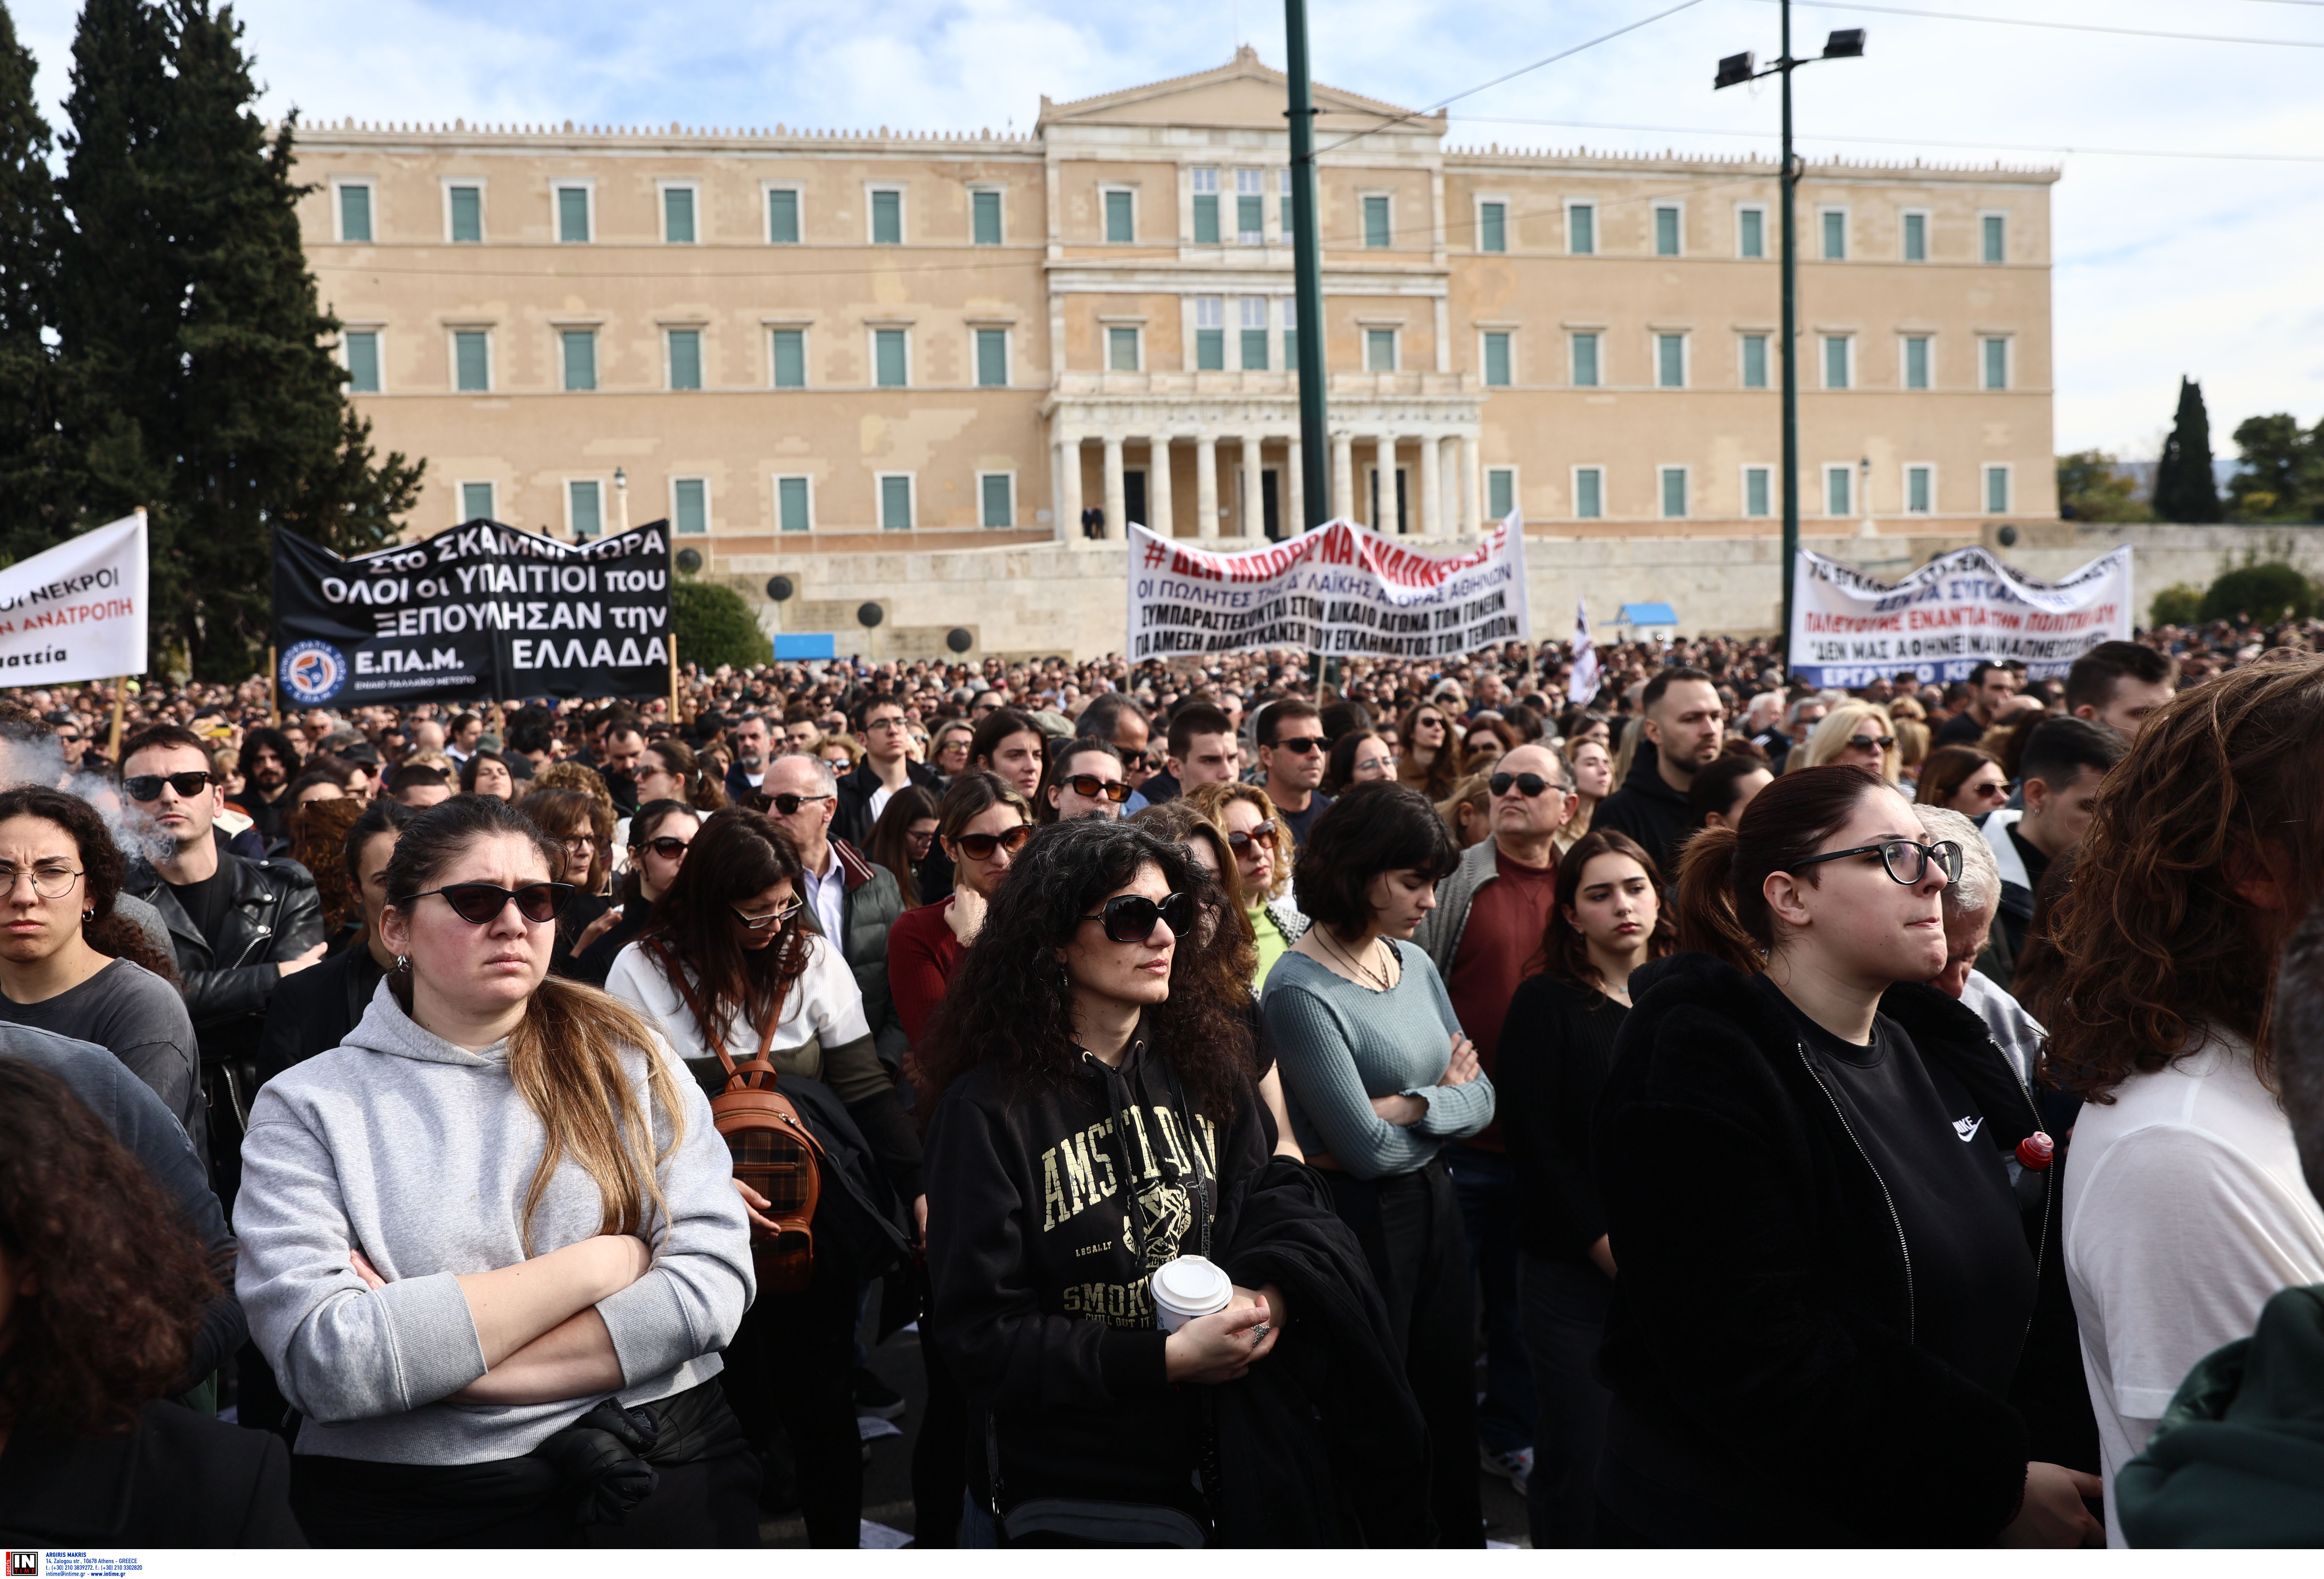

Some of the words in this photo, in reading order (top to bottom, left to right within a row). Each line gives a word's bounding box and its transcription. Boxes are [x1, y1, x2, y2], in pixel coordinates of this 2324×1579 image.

[30, 567, 119, 605] ΝΕΚΡΟΙ
[321, 577, 409, 605] ΟΛΟΙ
[416, 576, 450, 598] οι
[455, 563, 597, 594] ΥΠΑΙΤΙΟΙ
[604, 568, 666, 593] που
[1136, 579, 1153, 599] ΟΙ
[1160, 580, 1251, 608] ΠΩΛΗΤΕΣ
[1449, 563, 1513, 598] ΑΘΗΝΩΝ
[23, 597, 134, 631] ΑΝΑΤΡΟΠΗ
[373, 601, 602, 638] ΞΕΠΟΥΛΗΣΑΝ
[609, 605, 667, 635] την
[512, 636, 669, 669] ΕΛΛΑΔΑ
[1952, 1116, 1976, 1134] NIKE
[1075, 1241, 1112, 1257] LEGALLY
[1116, 1317, 1135, 1328] OUT
